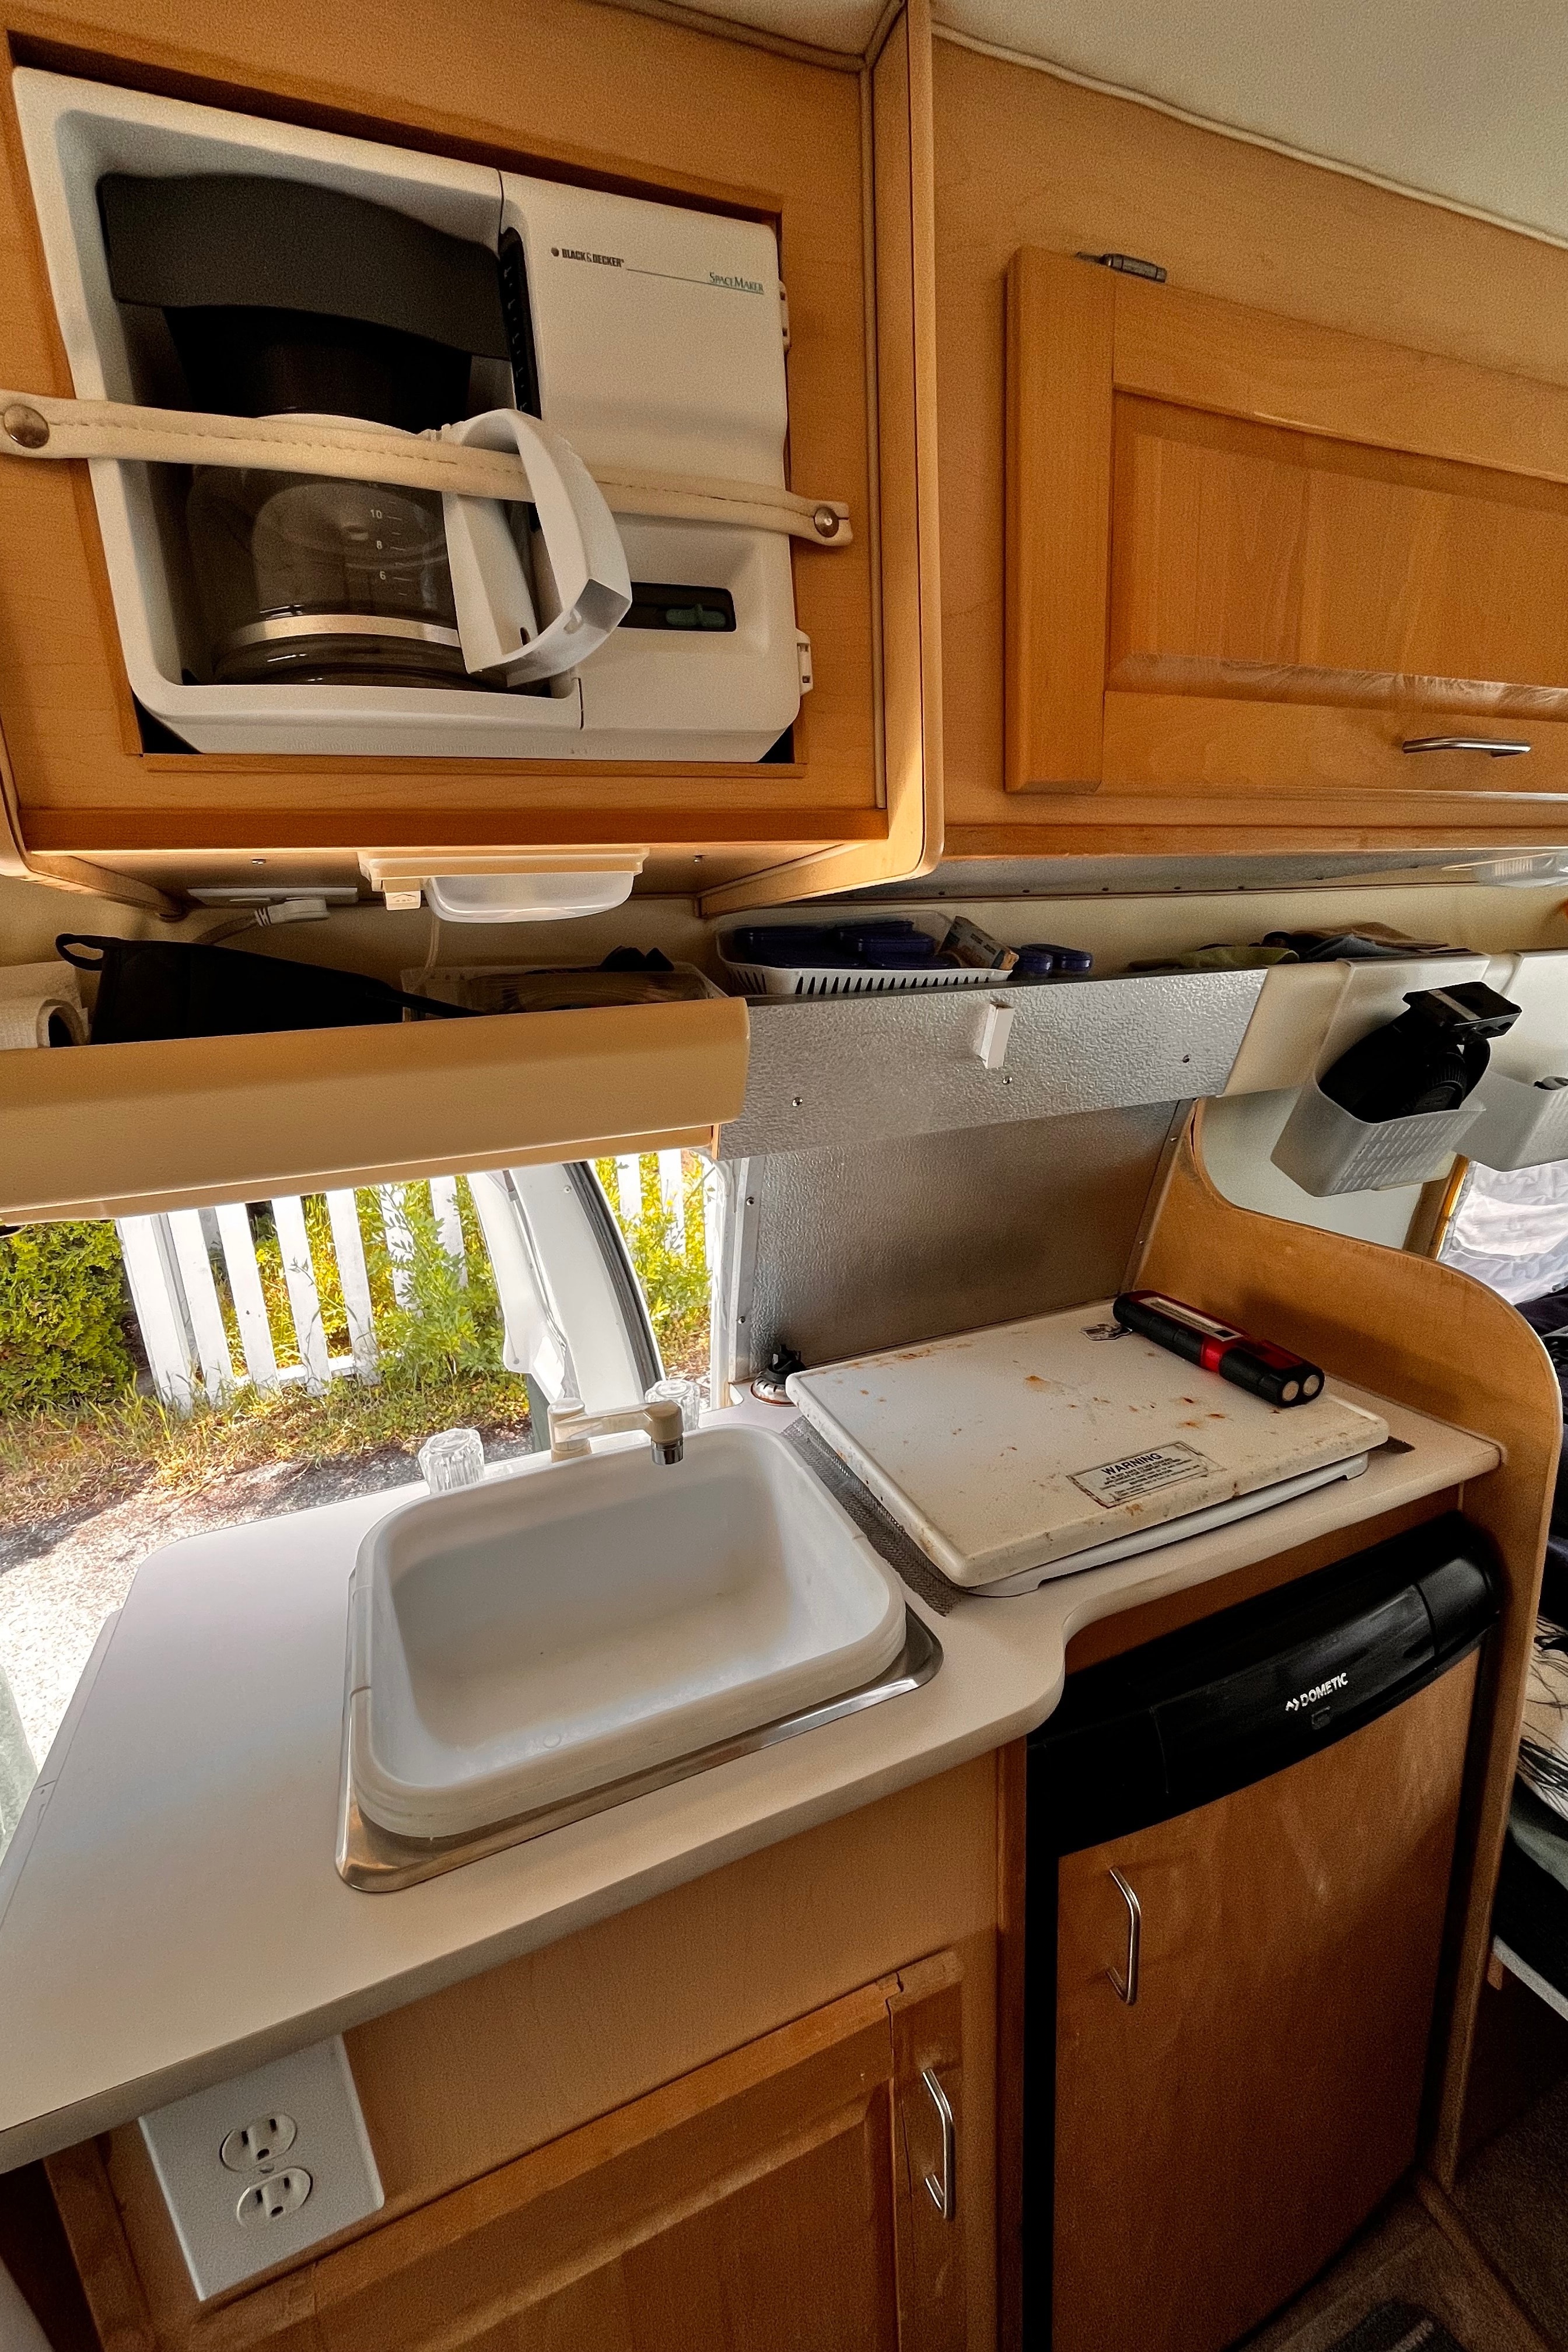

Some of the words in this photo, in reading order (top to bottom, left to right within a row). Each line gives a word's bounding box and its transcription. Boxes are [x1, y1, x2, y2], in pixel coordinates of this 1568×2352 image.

[370, 509, 382, 519] 10
[376, 540, 383, 550] 8
[379, 570, 386, 580] 6
[1101, 1453, 1163, 1475] WARNING
[1300, 1672, 1349, 1707] DOMETIC
